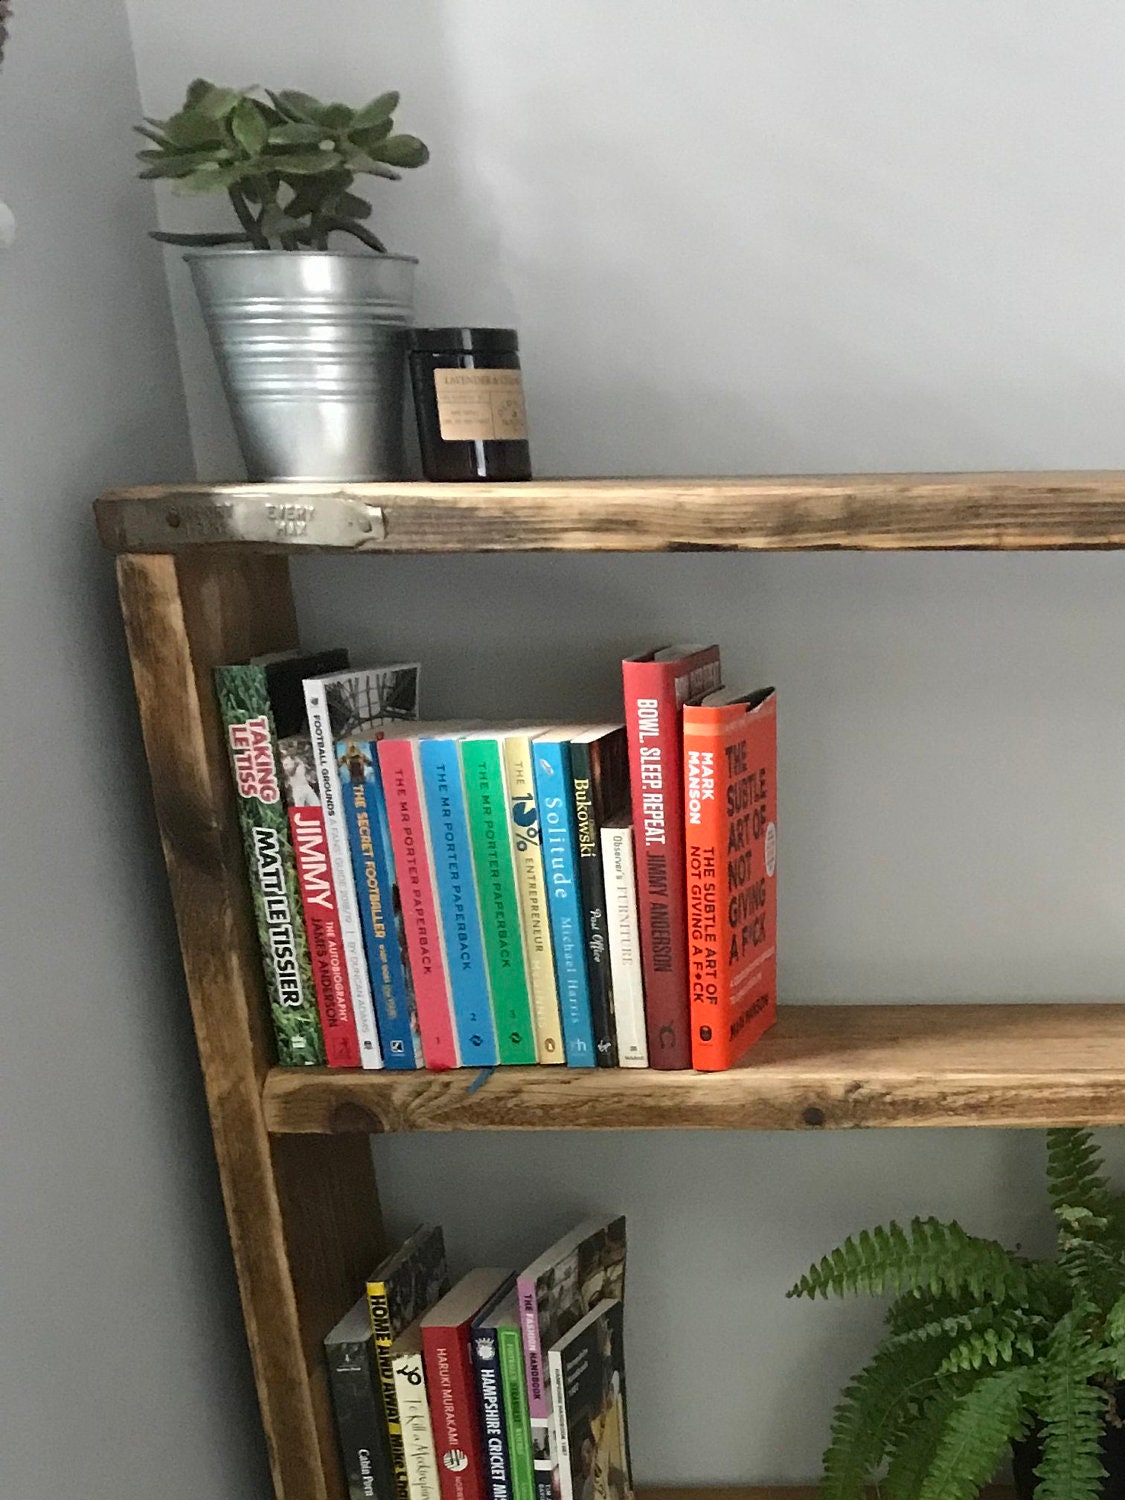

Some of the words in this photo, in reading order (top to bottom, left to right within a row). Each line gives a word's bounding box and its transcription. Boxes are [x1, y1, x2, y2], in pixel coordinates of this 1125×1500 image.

[230, 723, 250, 750] LE
[312, 713, 328, 765] FOOTBALL
[635, 696, 660, 744] BOWL.
[234, 752, 258, 798] TISS
[247, 717, 279, 804] TAKING
[434, 764, 448, 792] THE
[476, 761, 489, 791] THE
[637, 745, 663, 790] SLEEP.
[699, 751, 715, 800] MARK
[725, 740, 748, 778] THE
[320, 767, 336, 817] GROUNDS
[351, 784, 366, 809] THE
[393, 768, 406, 797] THE
[480, 793, 492, 815] MR
[685, 750, 702, 824] MANSON
[726, 768, 767, 817] SUBTLE
[398, 800, 410, 823] MR
[439, 795, 451, 818] MR
[572, 777, 596, 858] Bukowski
[640, 791, 667, 847] REPEAT.
[727, 814, 750, 854] ART
[752, 804, 767, 840] OF
[354, 811, 374, 857] SECRET
[401, 826, 419, 885] PORTER
[441, 821, 460, 881] PORTER
[483, 819, 500, 878] PORTER
[513, 761, 525, 786] THE
[522, 856, 544, 953] ENTREPRENEUR
[542, 795, 574, 899] Solitude
[612, 834, 625, 880] Observer's
[253, 826, 284, 896] MATT
[292, 813, 334, 909] JIMMY
[333, 856, 347, 888] GUIDE
[643, 848, 668, 897] JIMMY
[688, 844, 702, 880] NOT
[701, 846, 715, 878] THE
[727, 850, 752, 892] NOT
[264, 895, 288, 924] LE
[361, 859, 388, 939] FOOTBALLER
[588, 907, 602, 931] Post
[688, 883, 704, 940] GIVING
[701, 881, 717, 942] SUBTLE
[728, 877, 767, 928] GIVING
[311, 918, 326, 957] JAMES
[324, 920, 335, 939] THE
[410, 888, 433, 975] PAPERBACK
[449, 884, 473, 971] PAPERBACK
[490, 881, 512, 969] PAPERBACK
[558, 915, 578, 973] Michael
[588, 932, 606, 963] Office
[617, 885, 633, 967] FURNITURE
[647, 900, 673, 974] ANDERSON
[270, 925, 301, 1005] TISSIER
[691, 944, 703, 956] A
[703, 946, 718, 980] ART
[728, 934, 740, 966] A
[317, 958, 338, 1028] ANDERSON
[326, 938, 349, 1023] AUTOBIOGRAPHY
[348, 955, 364, 998] DUNCAN
[704, 984, 718, 1006] OF
[355, 998, 370, 1034] ADAMS
[565, 978, 583, 1024] Harris
[369, 1293, 389, 1343] HOME
[522, 1293, 534, 1312] THE
[523, 1311, 538, 1352] FASHION
[377, 1342, 394, 1379] AND
[435, 1346, 452, 1388] HARUKI
[527, 1351, 542, 1400] HANDBOOK
[382, 1380, 401, 1426] AWAY
[403, 1412, 427, 1433] Kill
[440, 1387, 459, 1446] MURAKAMI
[479, 1367, 502, 1435] HAMPSHIRE
[355, 1447, 373, 1475] Cabin
[389, 1433, 406, 1469] Mike
[486, 1436, 506, 1482] CRICKET
[360, 1474, 376, 1498] Porn
[544, 1483, 552, 1496] TIM
